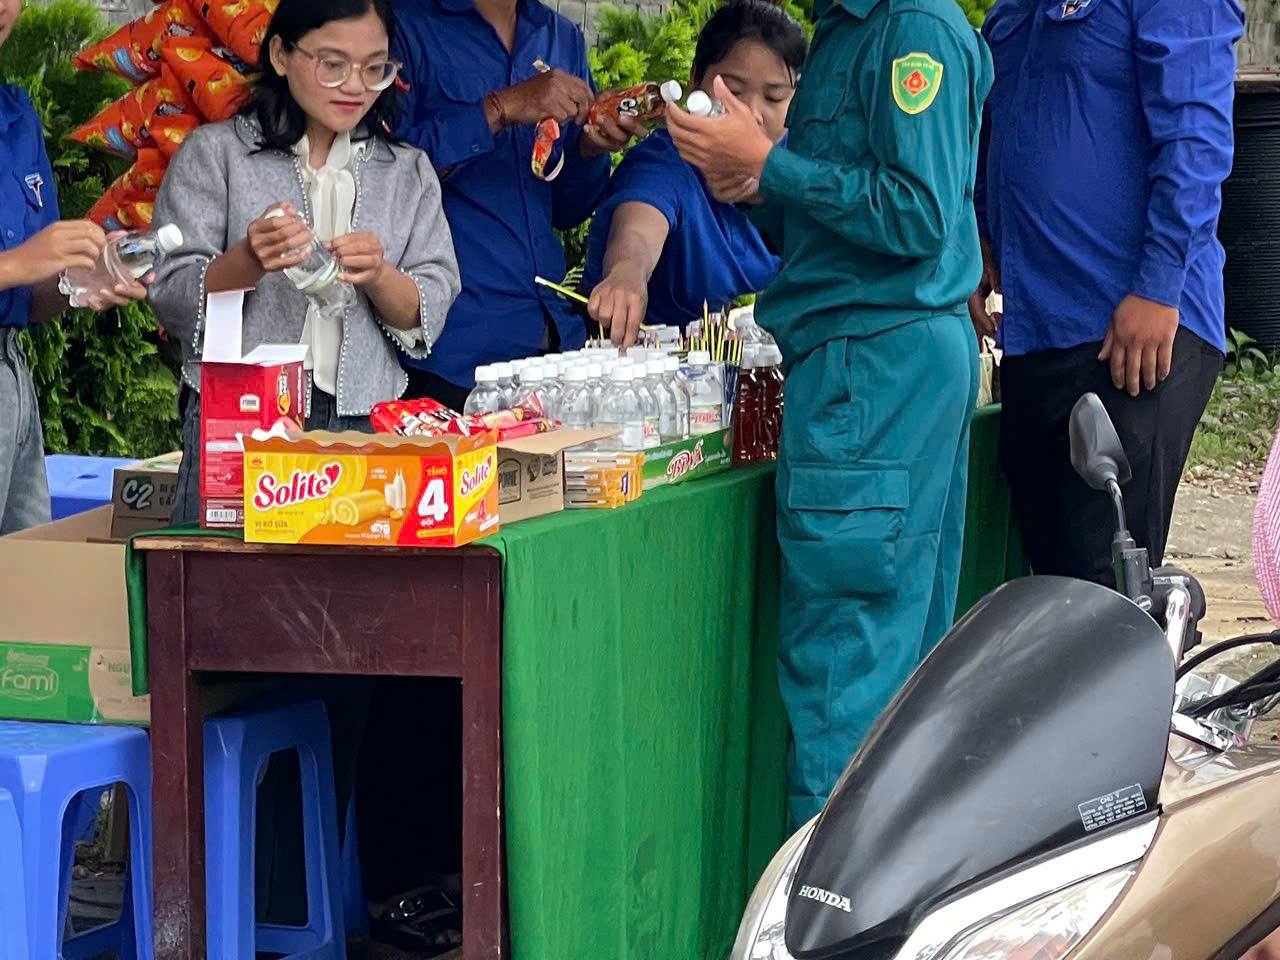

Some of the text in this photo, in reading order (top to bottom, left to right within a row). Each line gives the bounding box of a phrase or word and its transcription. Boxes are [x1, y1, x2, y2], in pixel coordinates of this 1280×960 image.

[122, 479, 154, 509] C2
[253, 470, 331, 510] Solite
[418, 478, 449, 522] 4
[798, 885, 851, 913] HONDA
